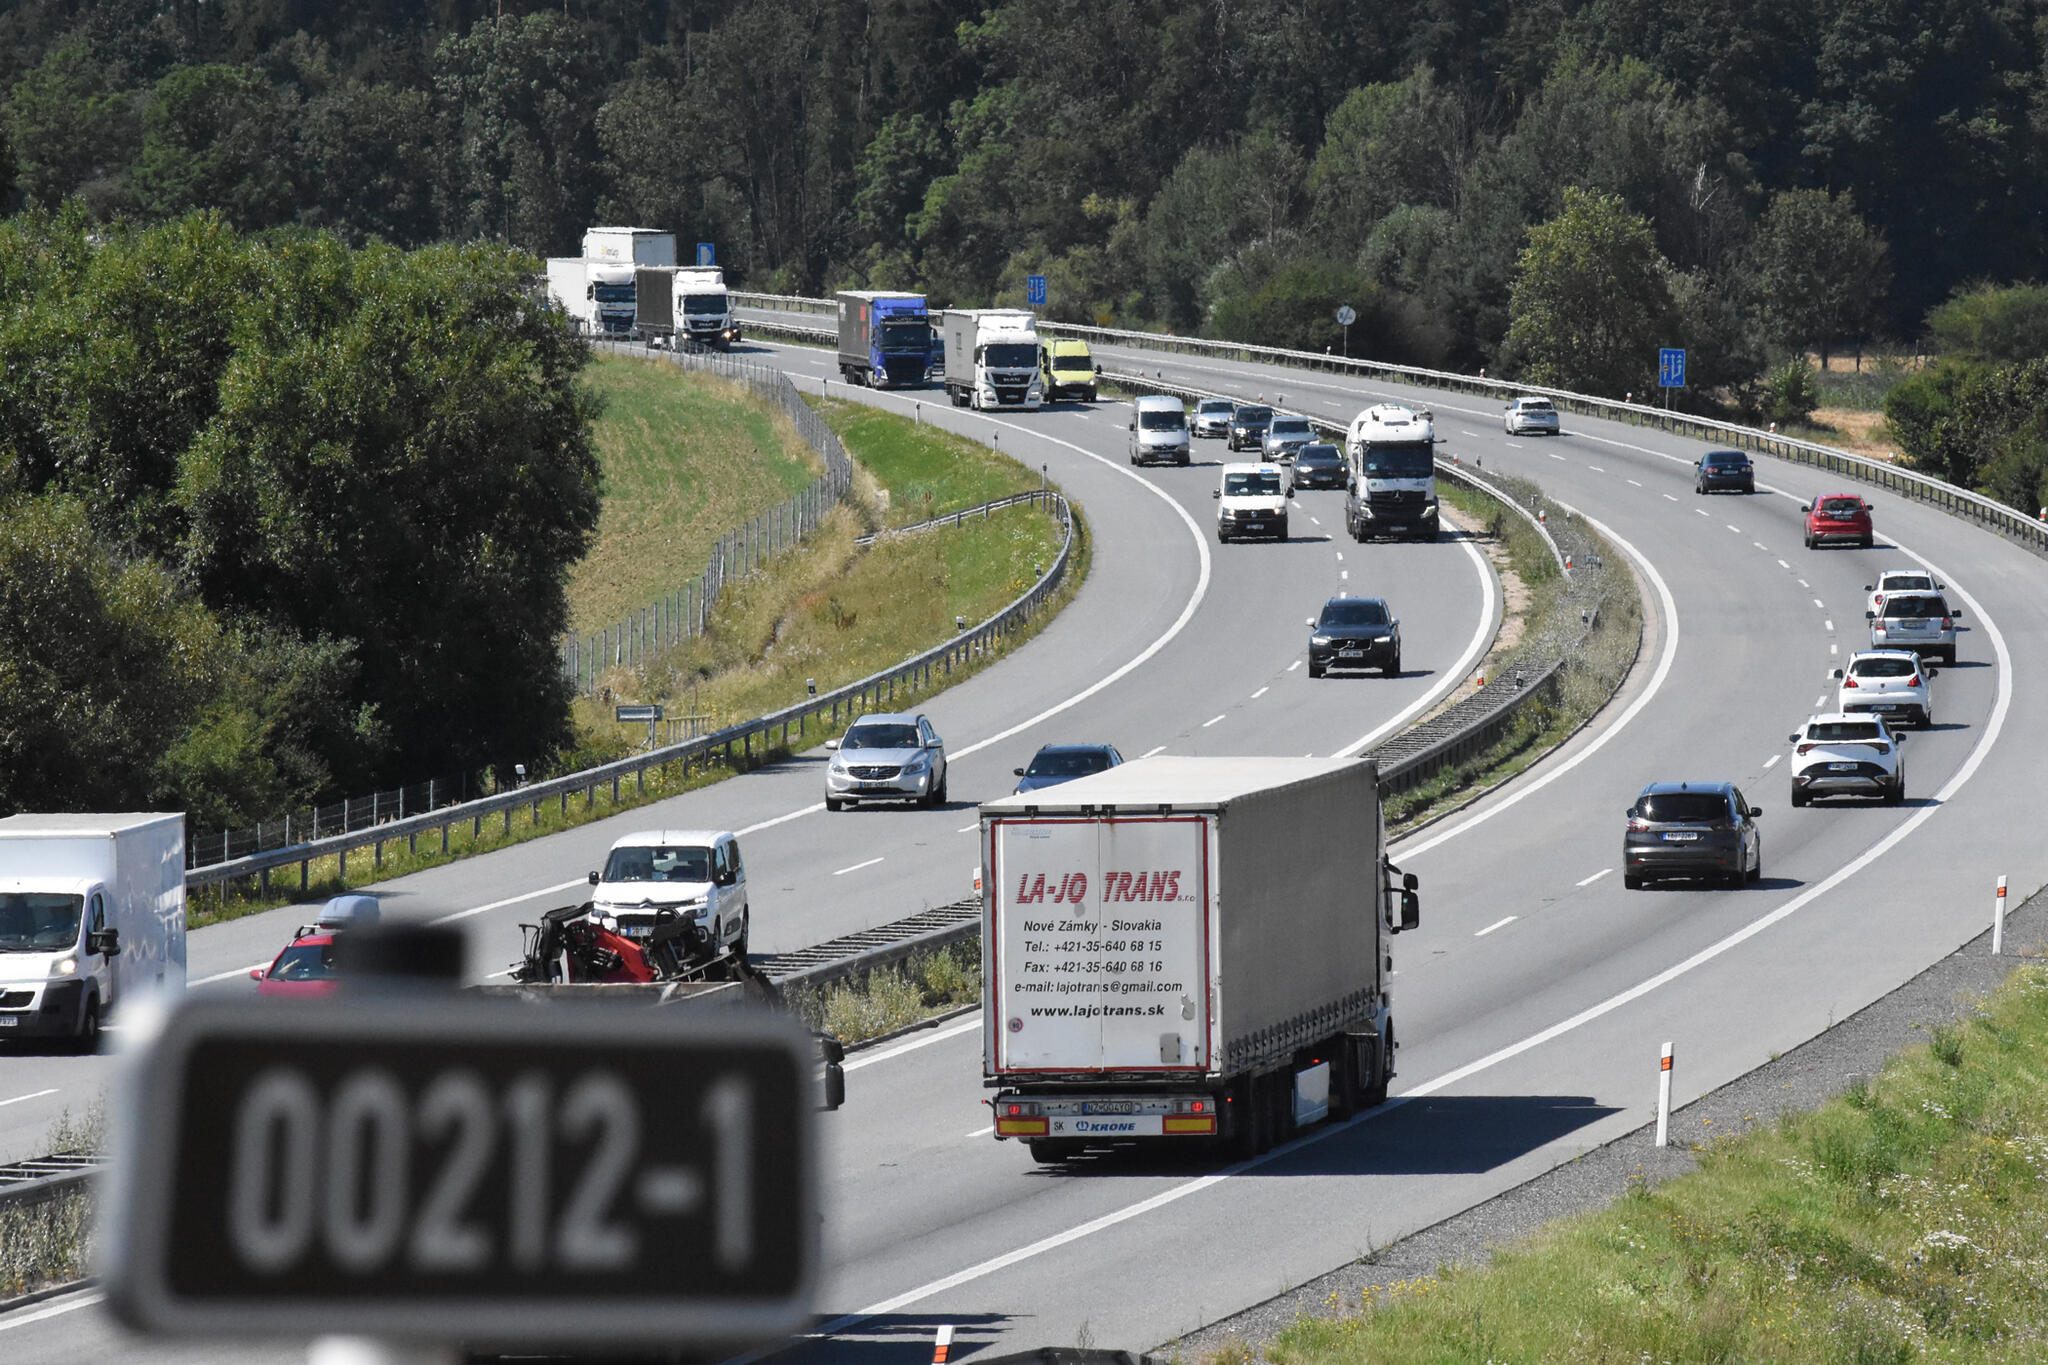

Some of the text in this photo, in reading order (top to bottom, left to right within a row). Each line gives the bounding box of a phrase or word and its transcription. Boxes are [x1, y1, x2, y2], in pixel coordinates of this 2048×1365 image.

[1016, 872, 1088, 904] LA-JO
[1103, 870, 1181, 903] TRANS
[1023, 920, 1055, 932] Nové
[1058, 920, 1098, 935] Zámky
[1111, 919, 1162, 931] Slovakia
[1024, 940, 1162, 953] Tel.: +421-35-640 68 15
[1024, 960, 1163, 974] Fax: +421-35-640 68 16
[1014, 980, 1183, 995] e-mail: lajotrans@gmail.com
[1030, 1004, 1165, 1018] www.lajotrans.sk
[1053, 1121, 1136, 1132] SK KRONE
[228, 1066, 757, 1272] 00212-1
